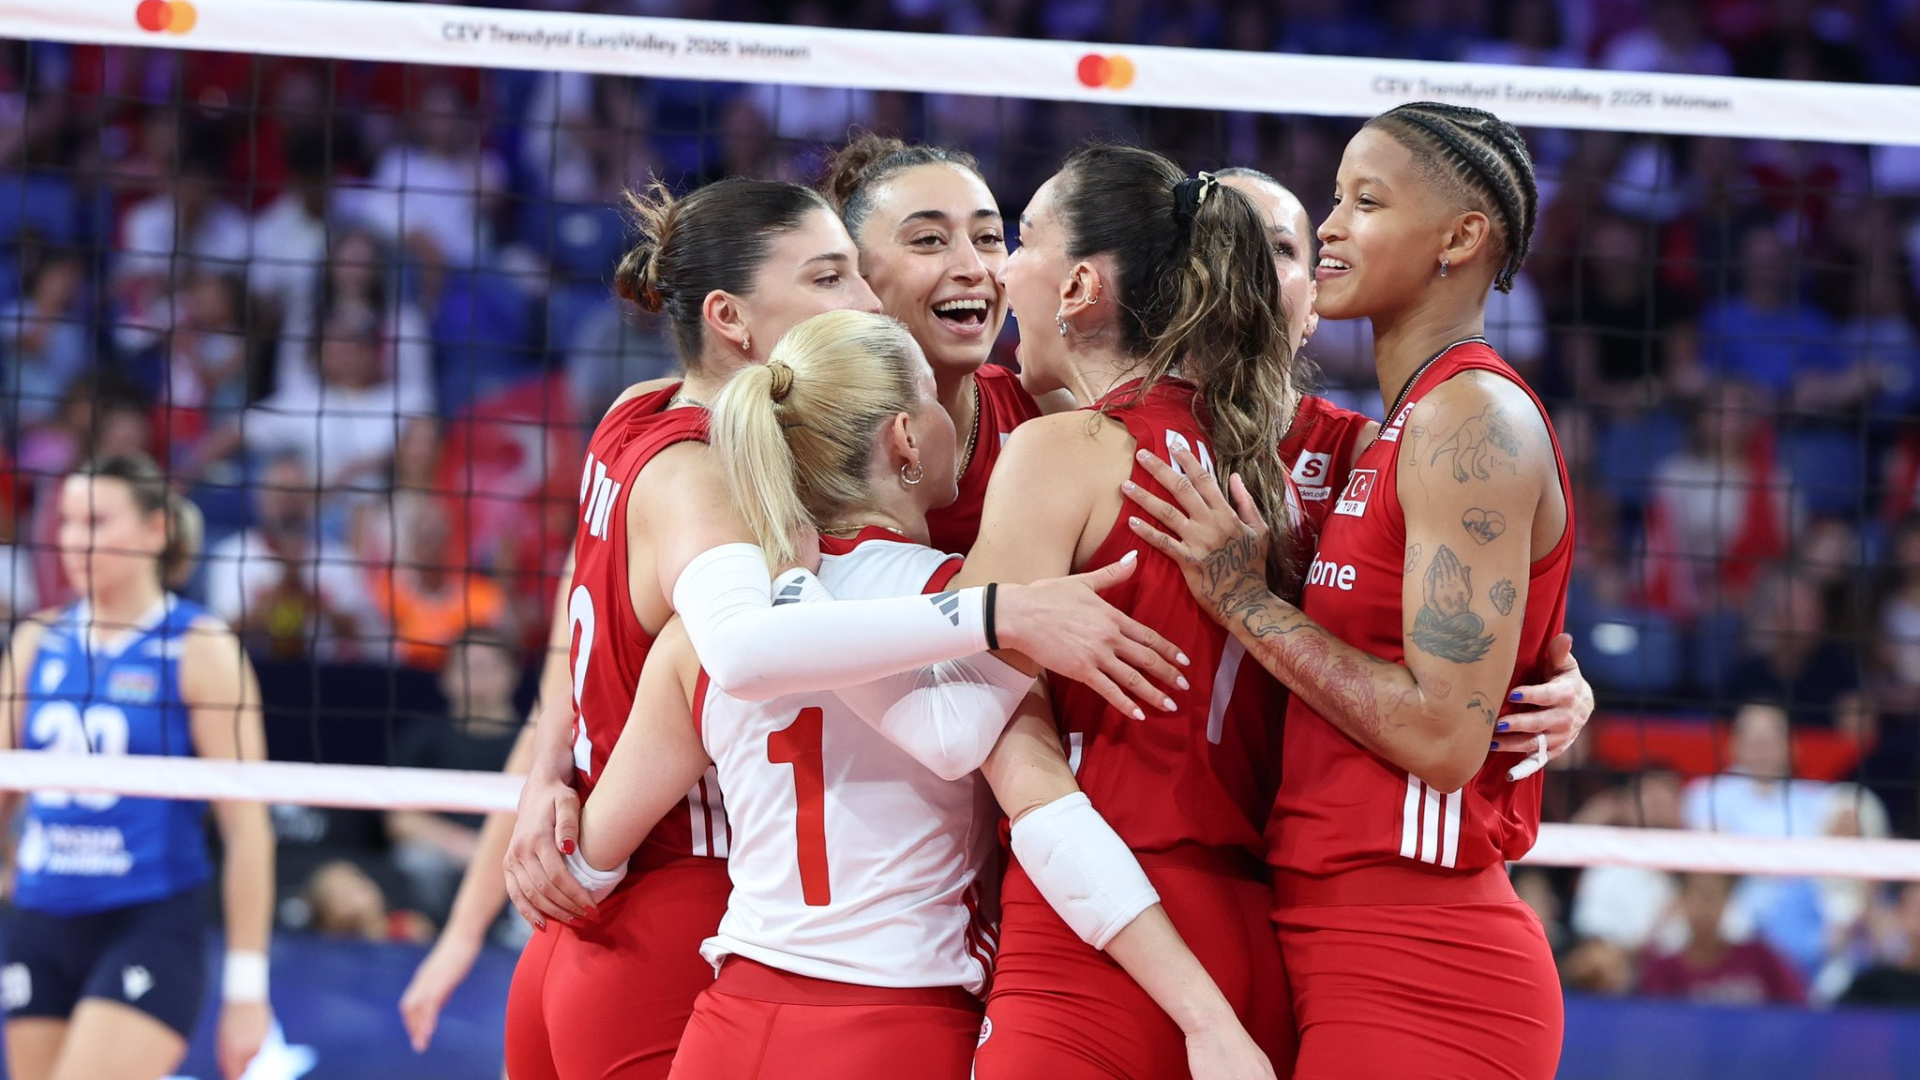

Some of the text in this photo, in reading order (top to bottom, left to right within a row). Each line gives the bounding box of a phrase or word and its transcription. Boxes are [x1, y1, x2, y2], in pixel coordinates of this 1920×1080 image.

[442, 21, 482, 41] CEV
[737, 40, 811, 59] Women
[1301, 458, 1323, 478] S
[1343, 502, 1358, 513] TUR
[767, 706, 831, 906] 1
